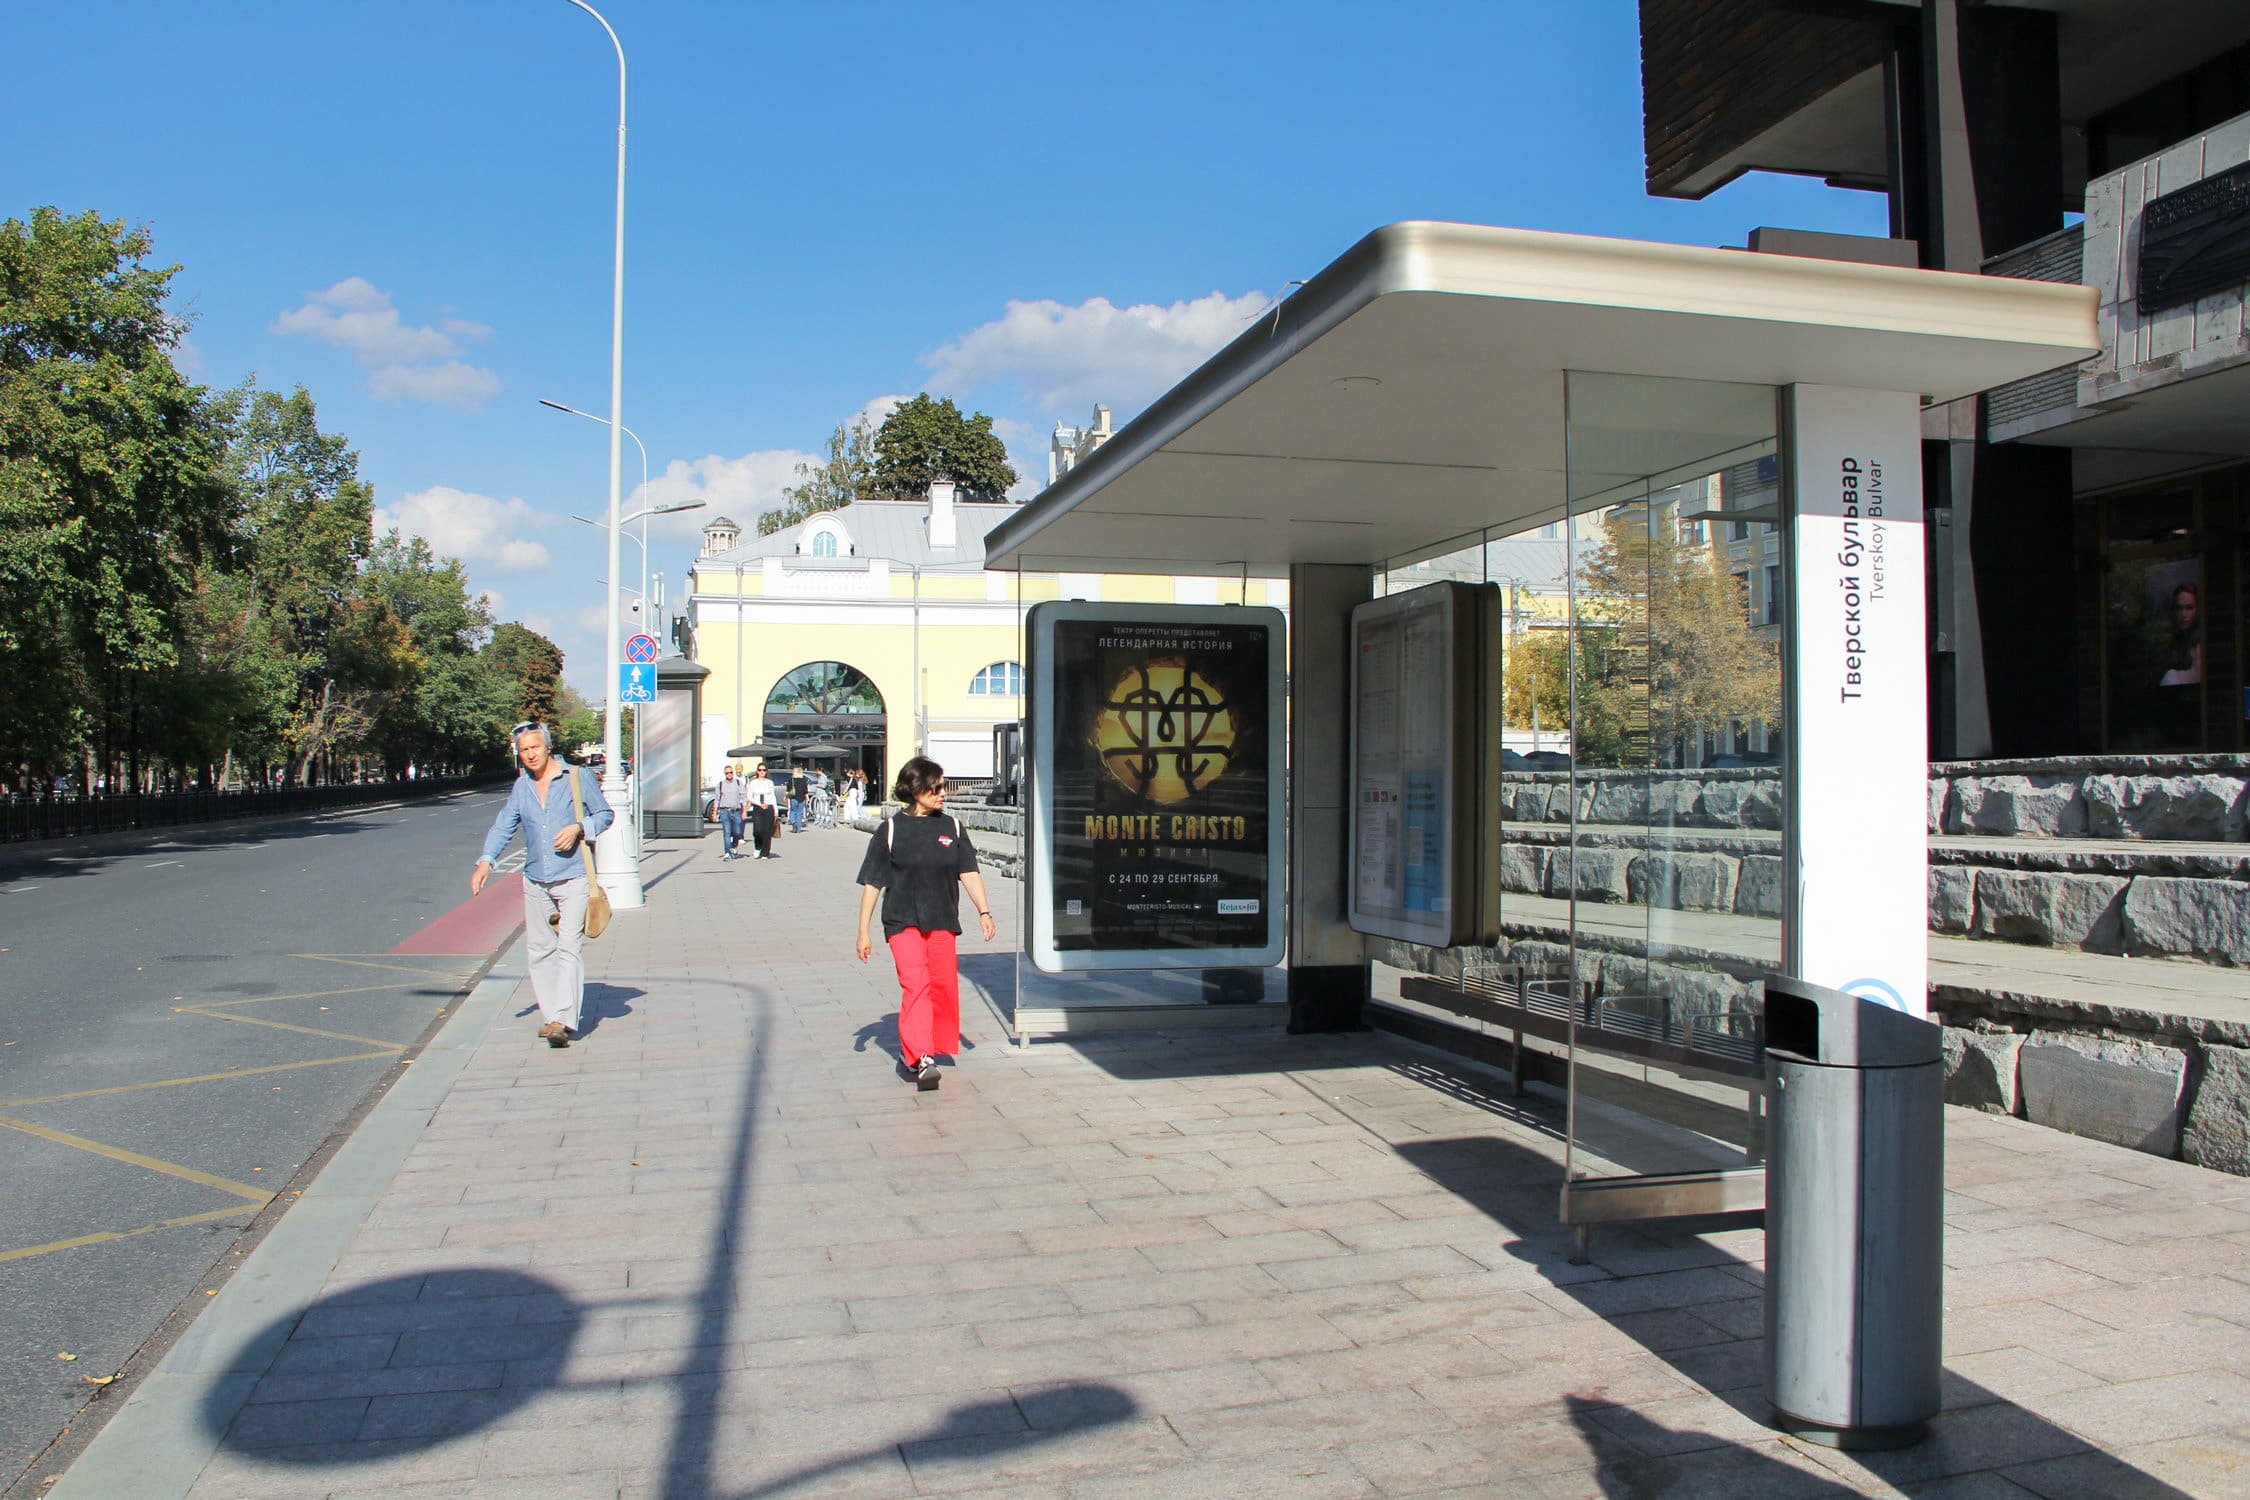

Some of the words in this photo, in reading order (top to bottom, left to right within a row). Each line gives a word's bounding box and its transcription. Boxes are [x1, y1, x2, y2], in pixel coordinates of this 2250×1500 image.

[1867, 459, 1883, 517] Bulvar
[1838, 457, 1865, 568] бульвар
[1868, 522, 1886, 603] Tverskoy
[1098, 637, 1177, 649] ЛЕГЕНДАРНАЯ
[1183, 639, 1232, 650] ИСТОРИЯ
[1113, 626, 1133, 635] ТЕАТР
[1839, 577, 1866, 704] Тверской
[1085, 815, 1161, 840] MONTE
[1171, 815, 1245, 840] CRISTO
[1109, 874, 1116, 883] С
[1119, 874, 1131, 883] 24
[1135, 874, 1149, 883] ПО
[1152, 874, 1164, 883] 29
[1168, 874, 1219, 883] СЕНТЯБРЯ
